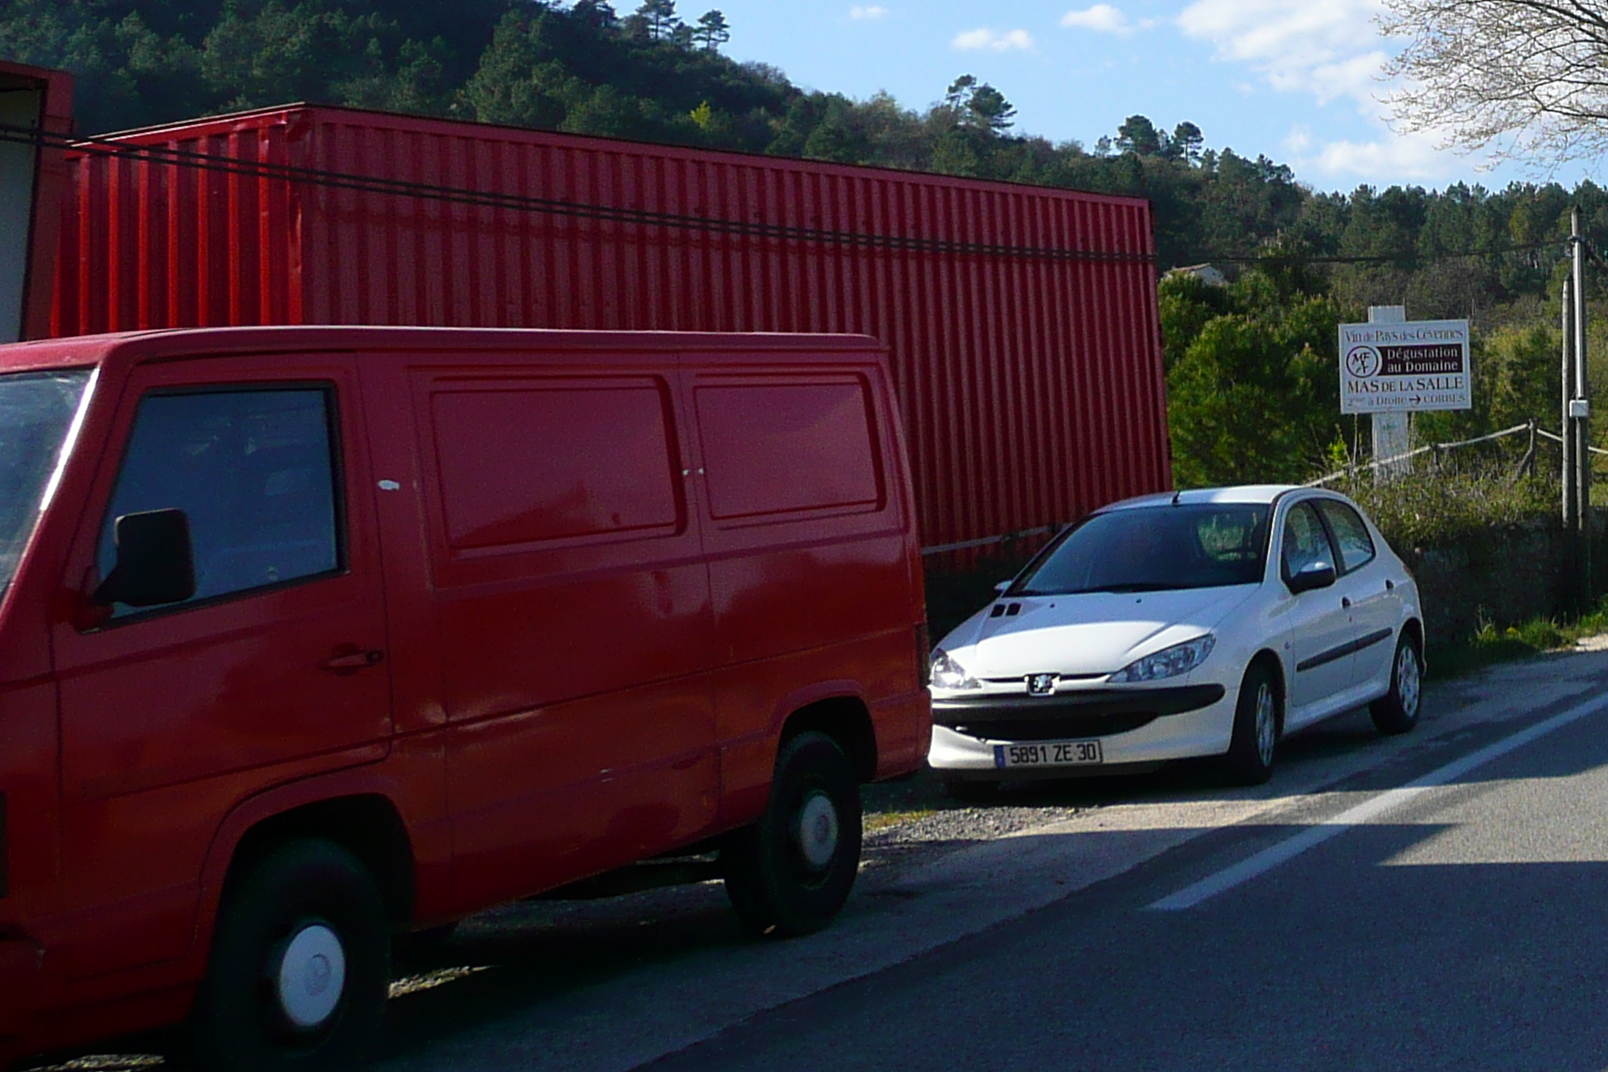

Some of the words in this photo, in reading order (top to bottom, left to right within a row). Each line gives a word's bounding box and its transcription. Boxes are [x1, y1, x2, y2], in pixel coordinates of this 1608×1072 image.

[1345, 331, 1361, 343] Vin
[1375, 330, 1398, 344] Pays
[1387, 347, 1458, 360] Dégustation
[1387, 363, 1402, 373] au
[1405, 359, 1458, 373] Domaine
[1347, 379, 1379, 394] MAS
[1381, 380, 1396, 392] DE
[1400, 380, 1413, 391] LA
[1416, 376, 1464, 391] SALLE
[1376, 395, 1405, 405] Droite
[1009, 745, 1048, 764] 5891
[1053, 744, 1075, 762] ZE
[1077, 743, 1097, 761] 30
